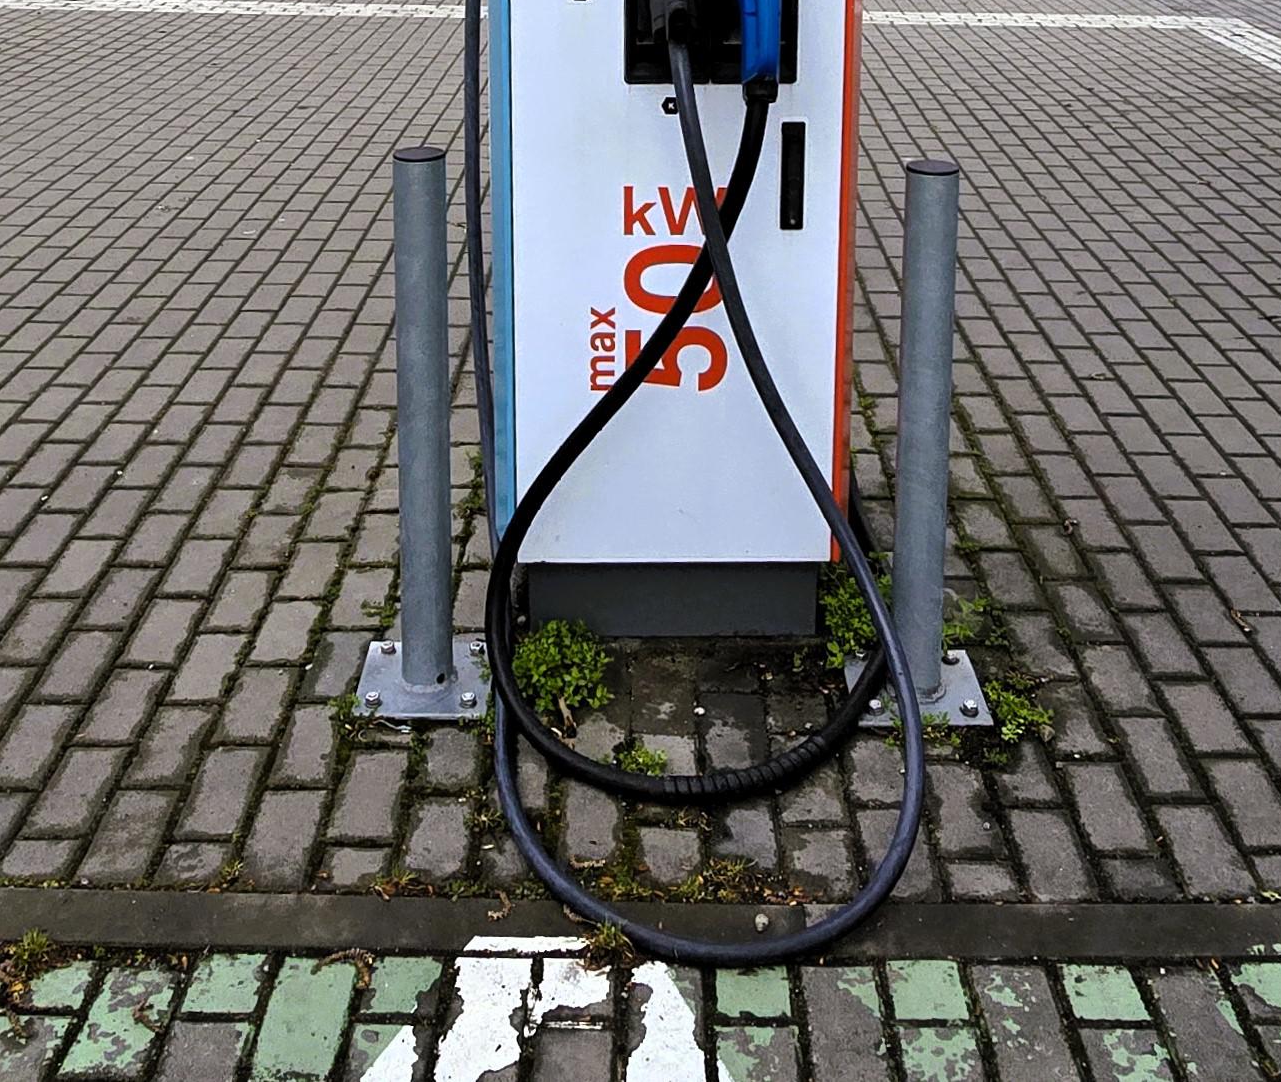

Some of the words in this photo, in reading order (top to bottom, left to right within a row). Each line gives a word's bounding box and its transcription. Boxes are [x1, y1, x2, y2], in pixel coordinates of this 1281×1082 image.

[668, 102, 675, 110] K
[623, 185, 729, 236] kW
[590, 306, 616, 392] max
[623, 244, 729, 392] 50
